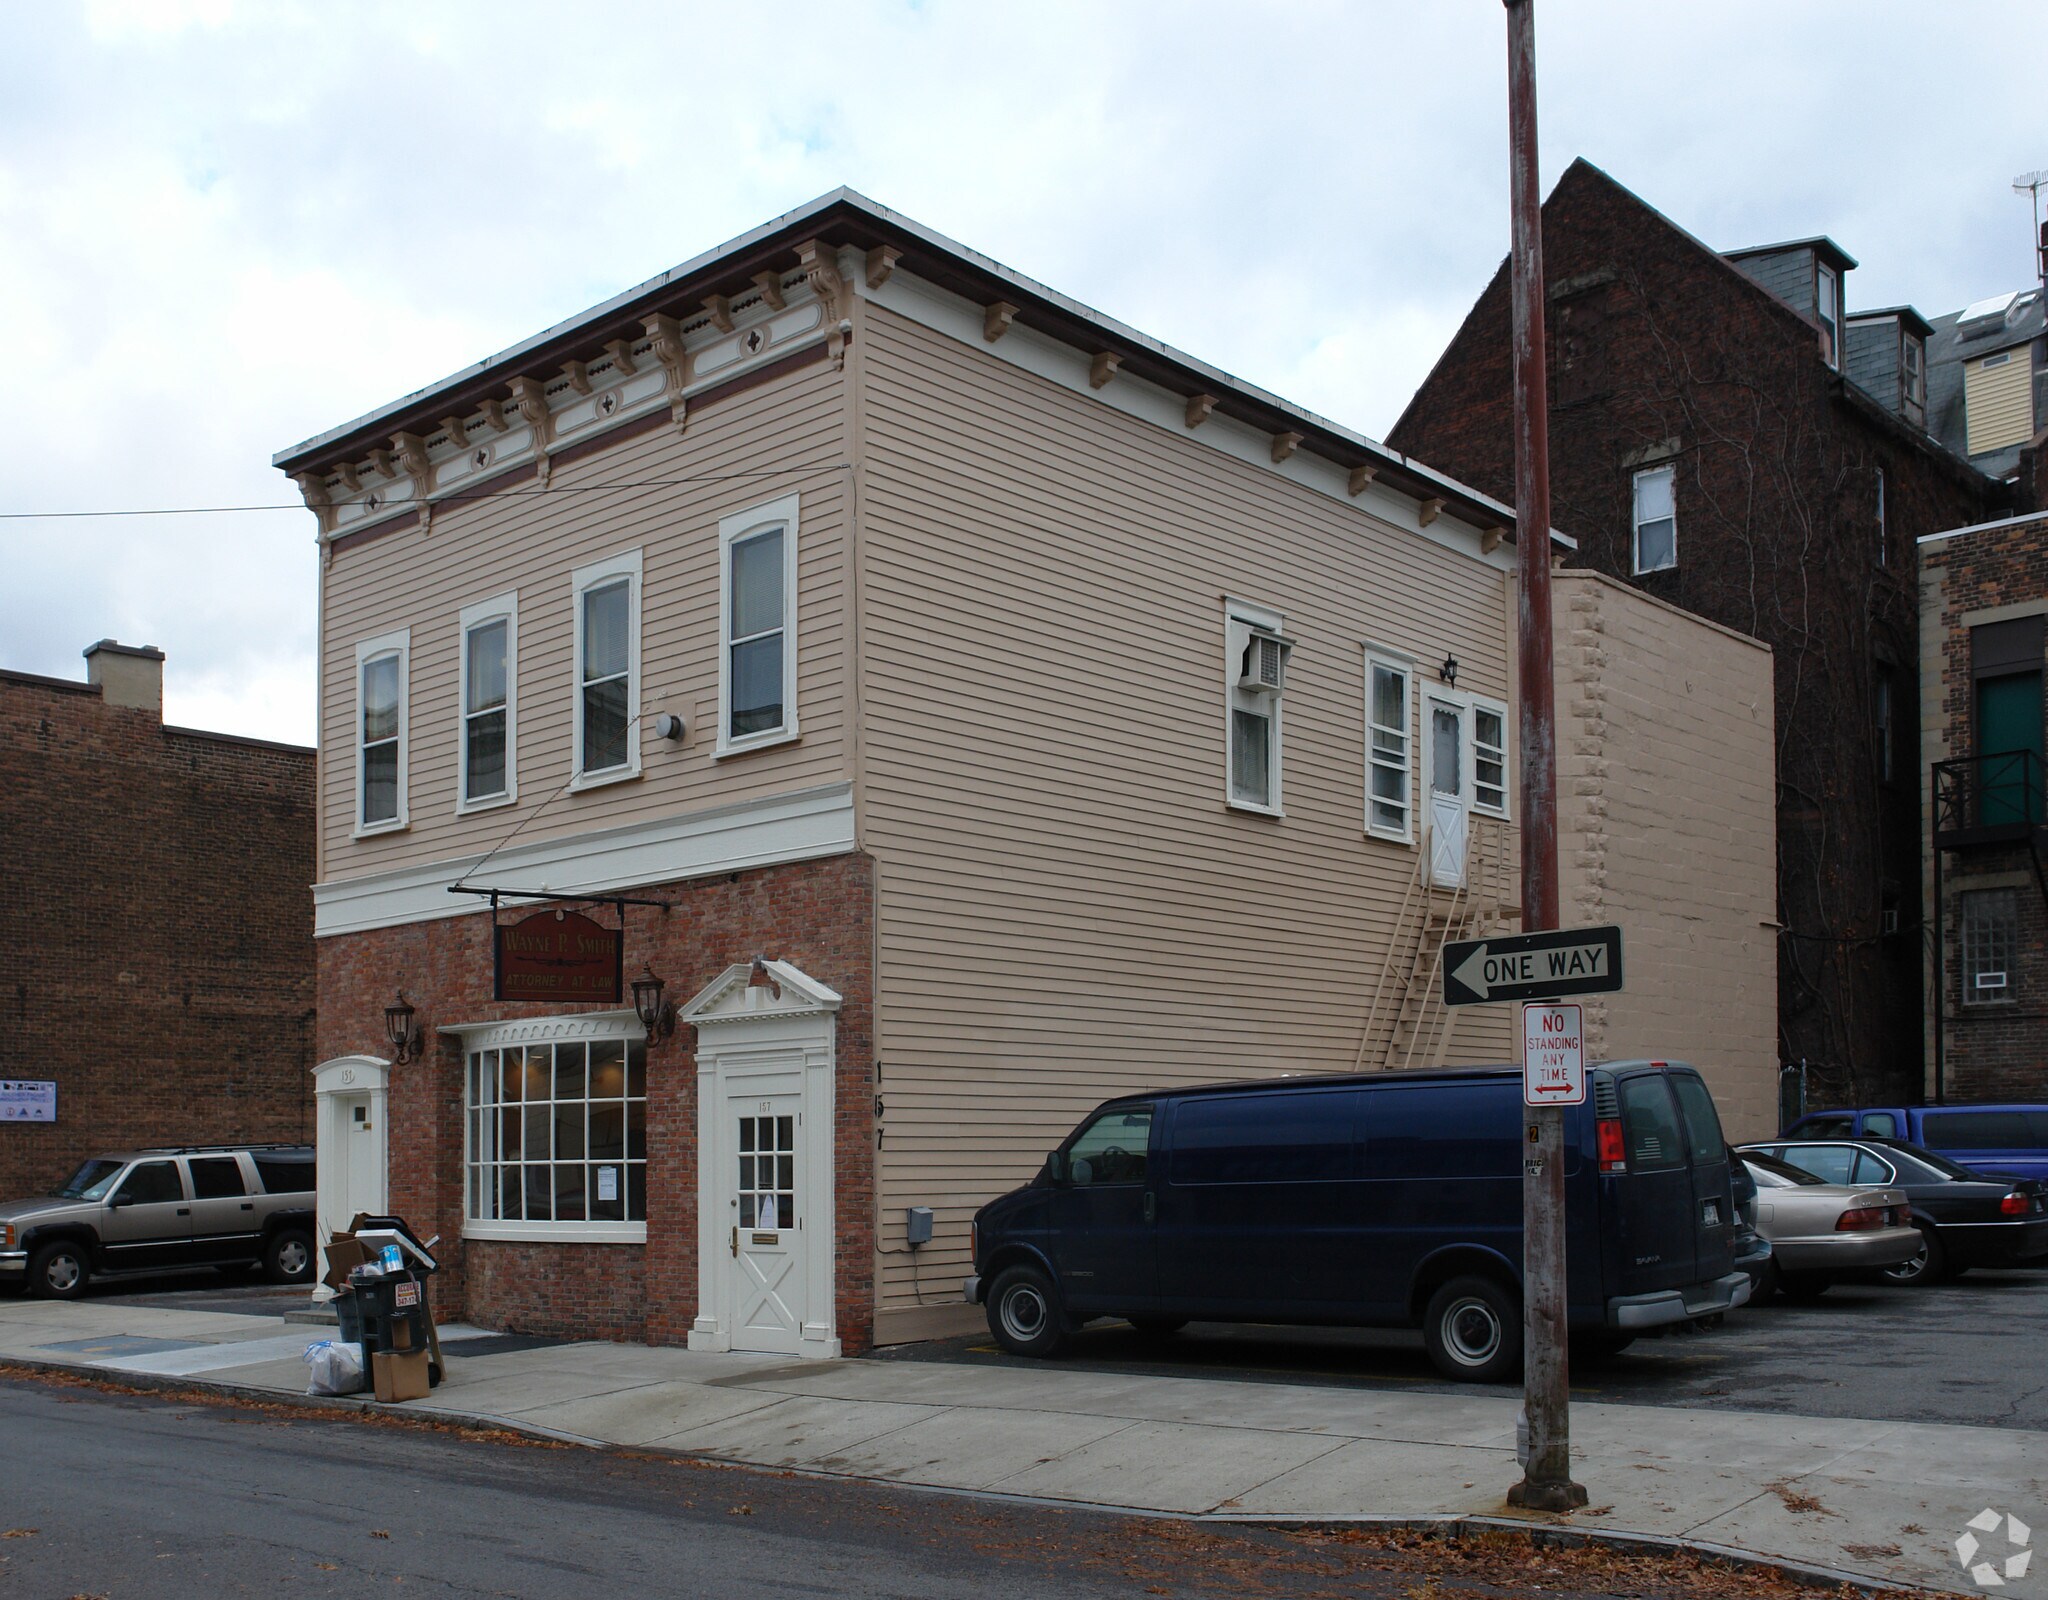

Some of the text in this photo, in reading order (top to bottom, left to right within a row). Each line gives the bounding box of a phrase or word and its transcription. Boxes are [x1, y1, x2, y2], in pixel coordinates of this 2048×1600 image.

[557, 933, 568, 952] P.
[577, 934, 615, 955] SMITH
[1483, 947, 1602, 983] ONE WAY
[505, 974, 614, 988] ATTORNEY AT LAW
[1542, 1014, 1564, 1032] NO
[1527, 1037, 1579, 1050] STANDING
[1542, 1053, 1564, 1066] ANY
[1540, 1068, 1568, 1081] TIME
[759, 1101, 771, 1112] 157
[1530, 1126, 1538, 1142] 2
